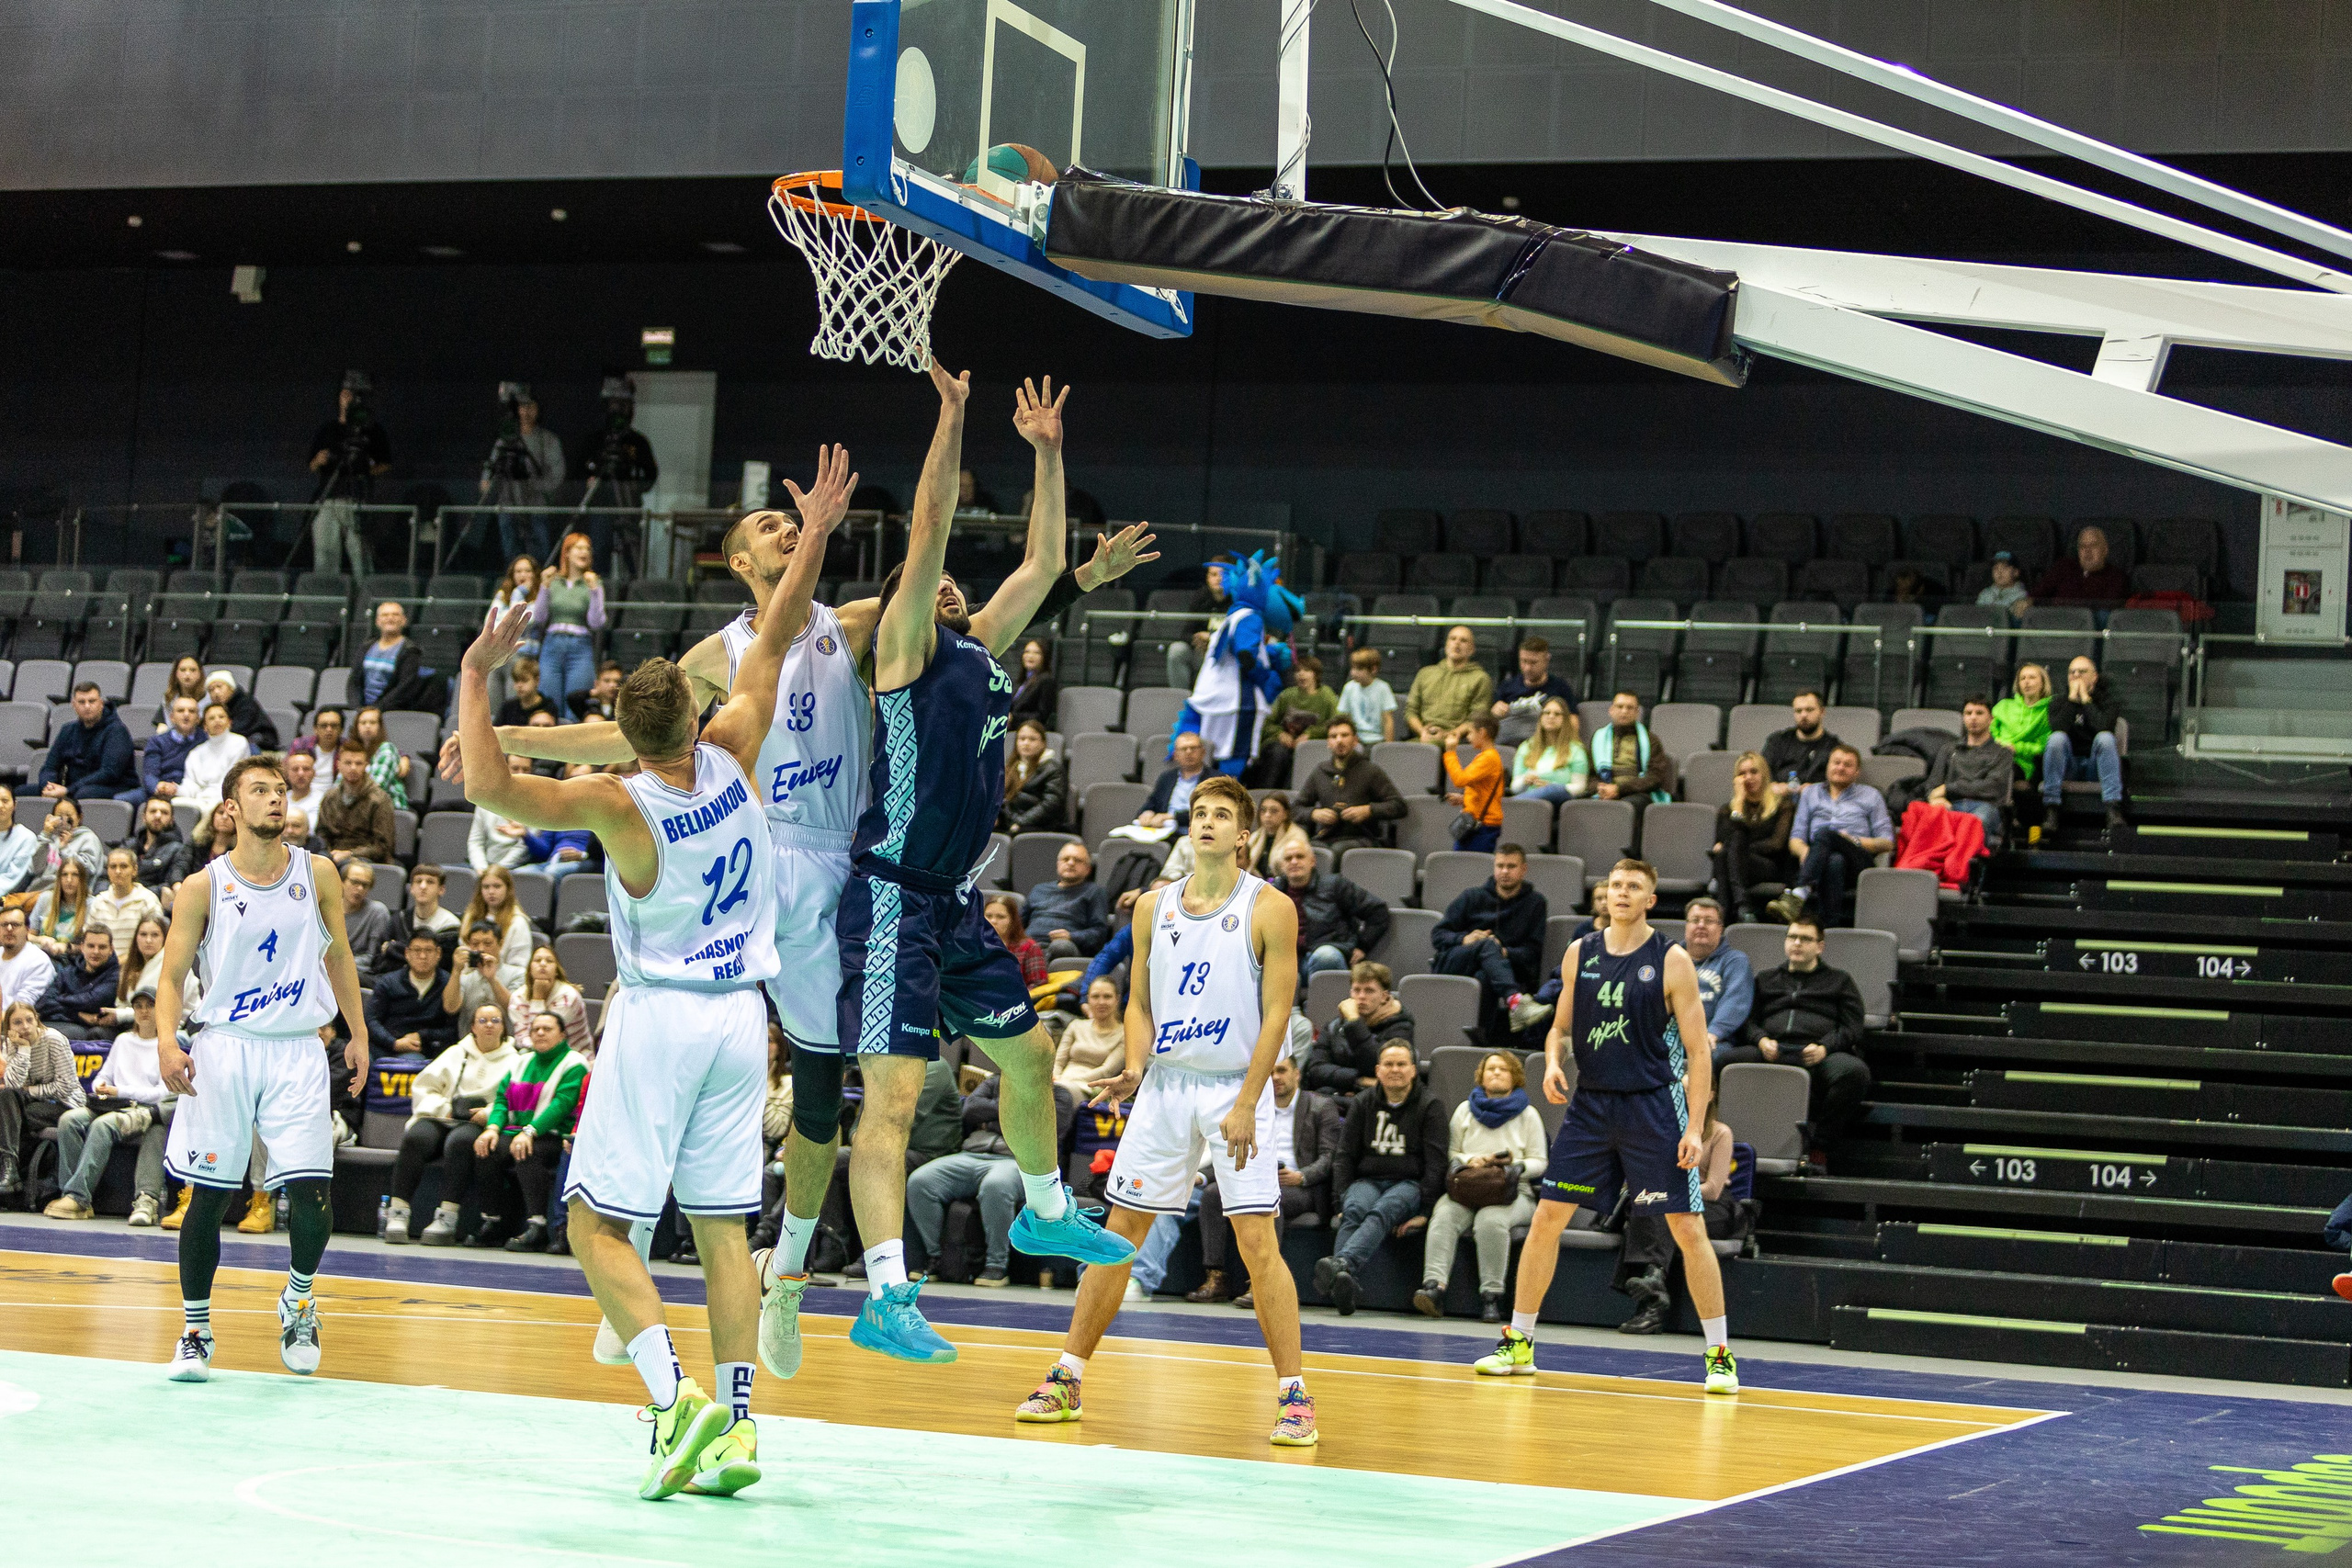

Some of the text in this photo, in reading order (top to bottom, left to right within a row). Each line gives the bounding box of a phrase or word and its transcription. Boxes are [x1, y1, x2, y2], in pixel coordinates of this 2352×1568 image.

[772, 754, 843, 804] Eniey
[662, 778, 748, 843] BELIANKOU
[702, 837, 752, 926] 12
[257, 928, 279, 963] 4
[1178, 961, 1212, 996] 13
[2100, 952, 2234, 978] 103 104
[229, 978, 305, 1022] Enisey
[1597, 980, 1626, 1008] 44
[901, 1022, 931, 1037] Kempa
[1156, 1016, 1231, 1055] Enisey
[1995, 1157, 2132, 1190] 103 104
